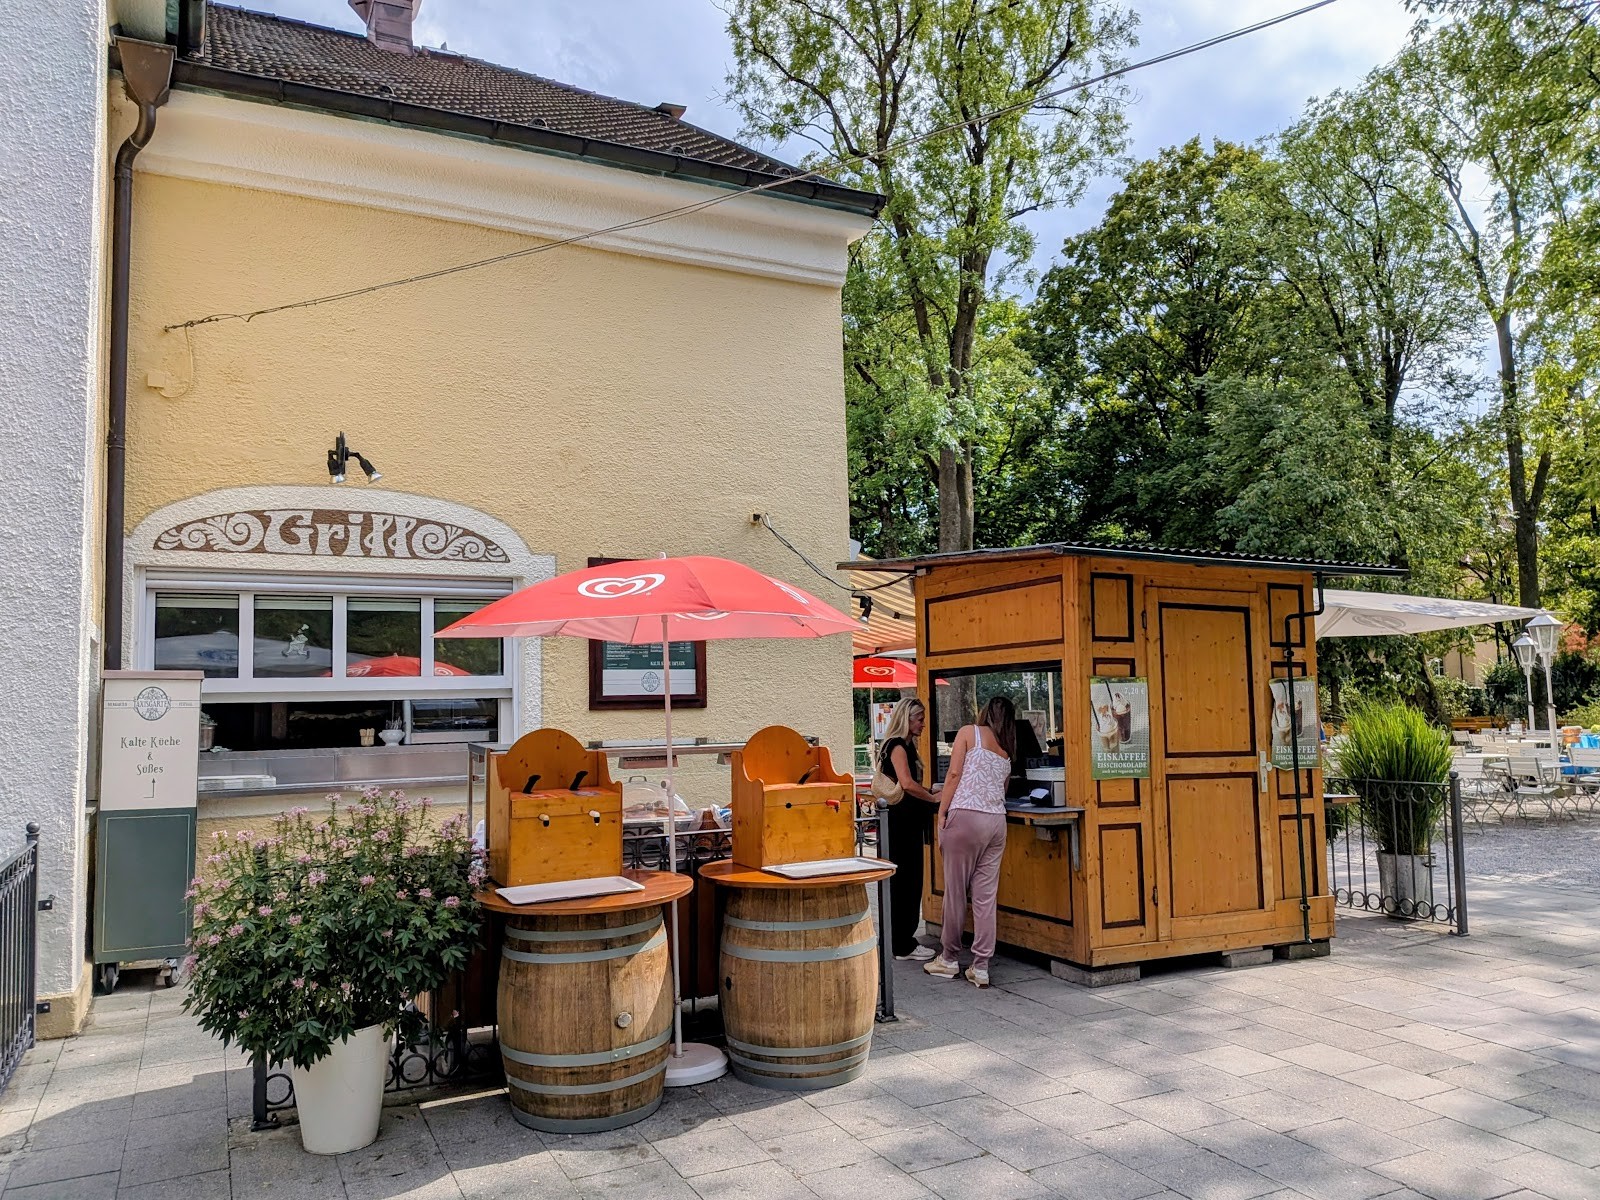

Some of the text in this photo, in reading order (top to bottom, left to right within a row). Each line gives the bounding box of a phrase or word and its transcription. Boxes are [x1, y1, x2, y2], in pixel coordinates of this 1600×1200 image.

[264, 510, 417, 558] Grill
[1124, 687, 1139, 696] 7,20
[120, 736, 181, 749] Kalte Küche
[1276, 745, 1317, 753] EISKFFEE
[147, 752, 153, 760] &
[1097, 752, 1147, 761] EISKAFFEE
